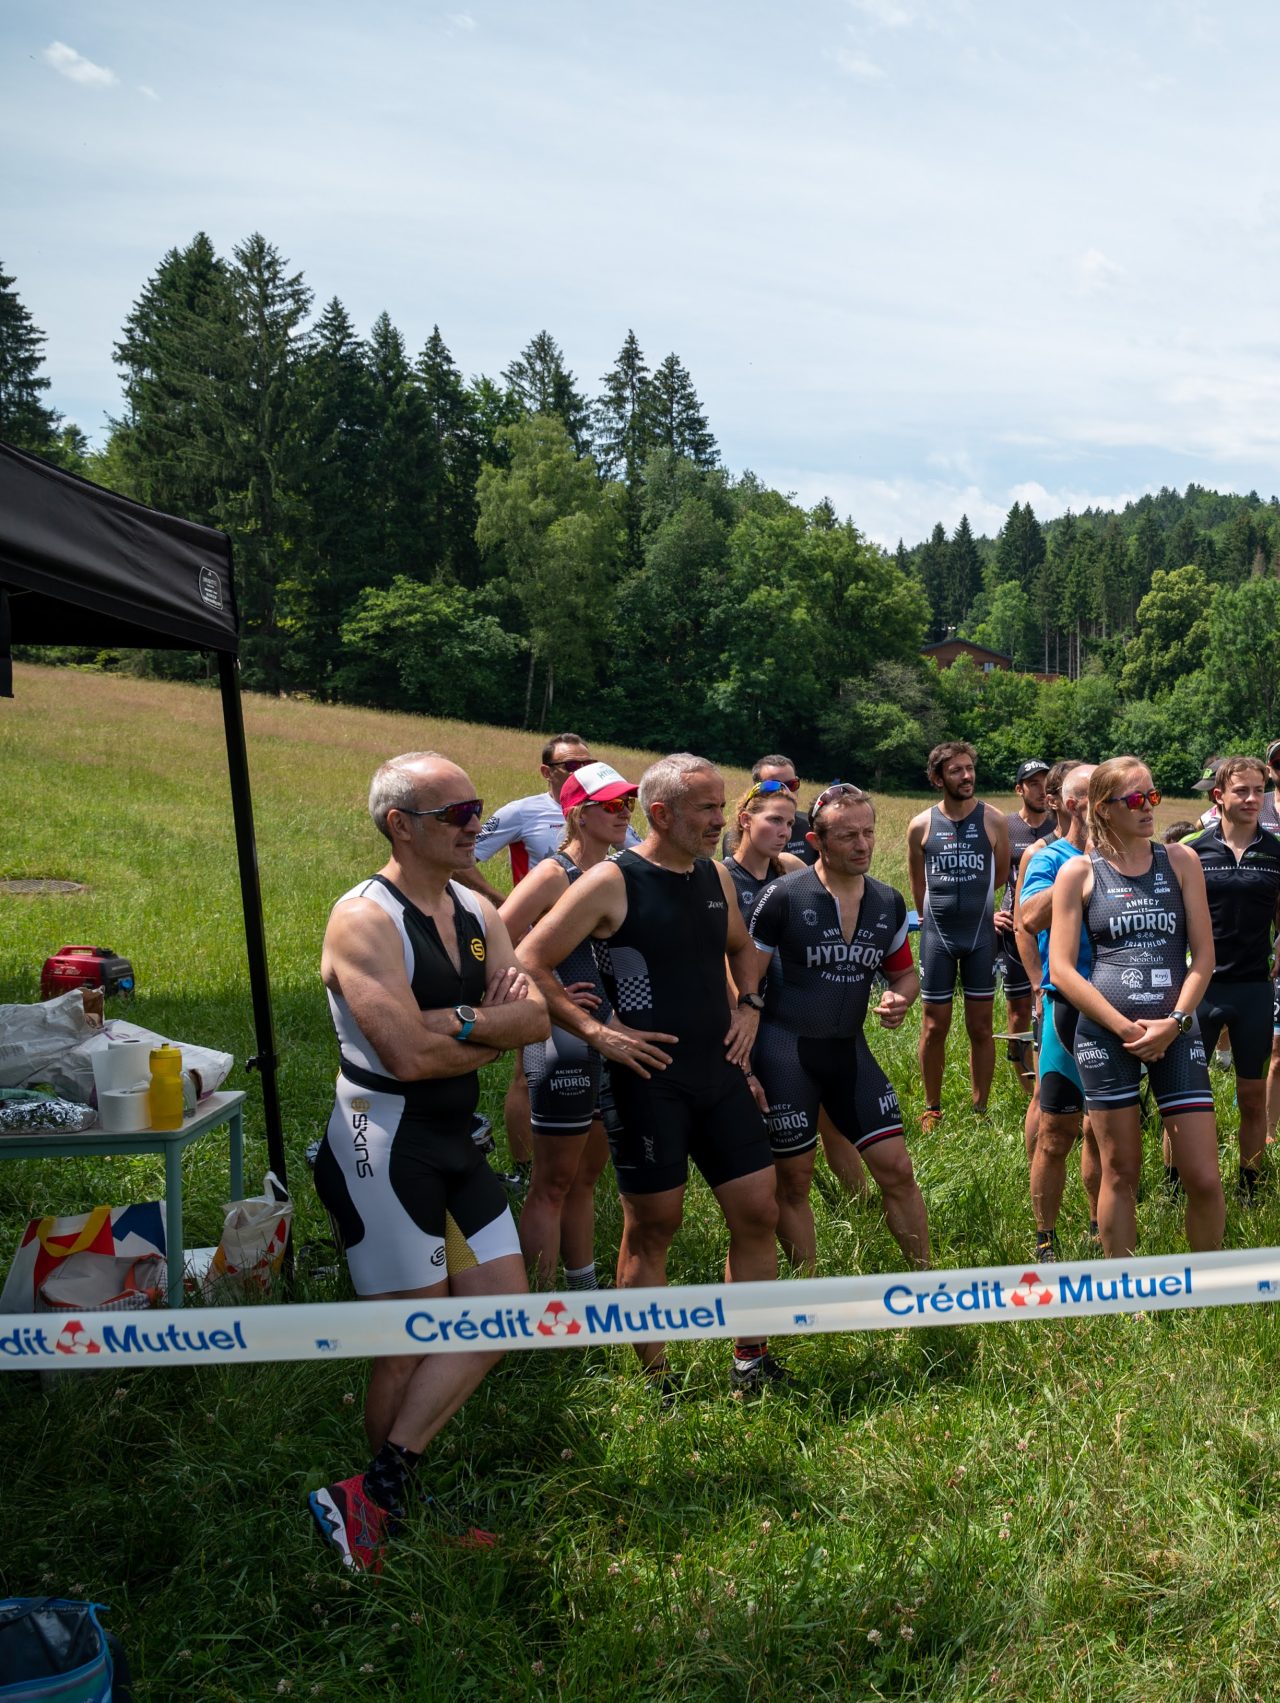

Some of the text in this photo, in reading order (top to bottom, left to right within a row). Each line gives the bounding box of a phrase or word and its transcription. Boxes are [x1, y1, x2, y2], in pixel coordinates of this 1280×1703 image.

[943, 842, 971, 851] ANNECY
[931, 854, 984, 875] HYDROS
[940, 874, 977, 883] TRIATHLON
[753, 884, 778, 917] TRIATHLON
[1126, 899, 1160, 909] ANNECY
[1109, 912, 1177, 940] HYDROS
[1124, 938, 1167, 948] TRIATHLON
[806, 945, 884, 970] HYDROS
[821, 971, 865, 983] TRIATHLON
[1077, 1048, 1109, 1065] HYDROS
[550, 1076, 591, 1091] HYDROS
[883, 1266, 1193, 1316] Crédit Mutuel
[404, 1297, 726, 1342] Crédit Mutuel
[102, 1320, 248, 1354] Mutuel
